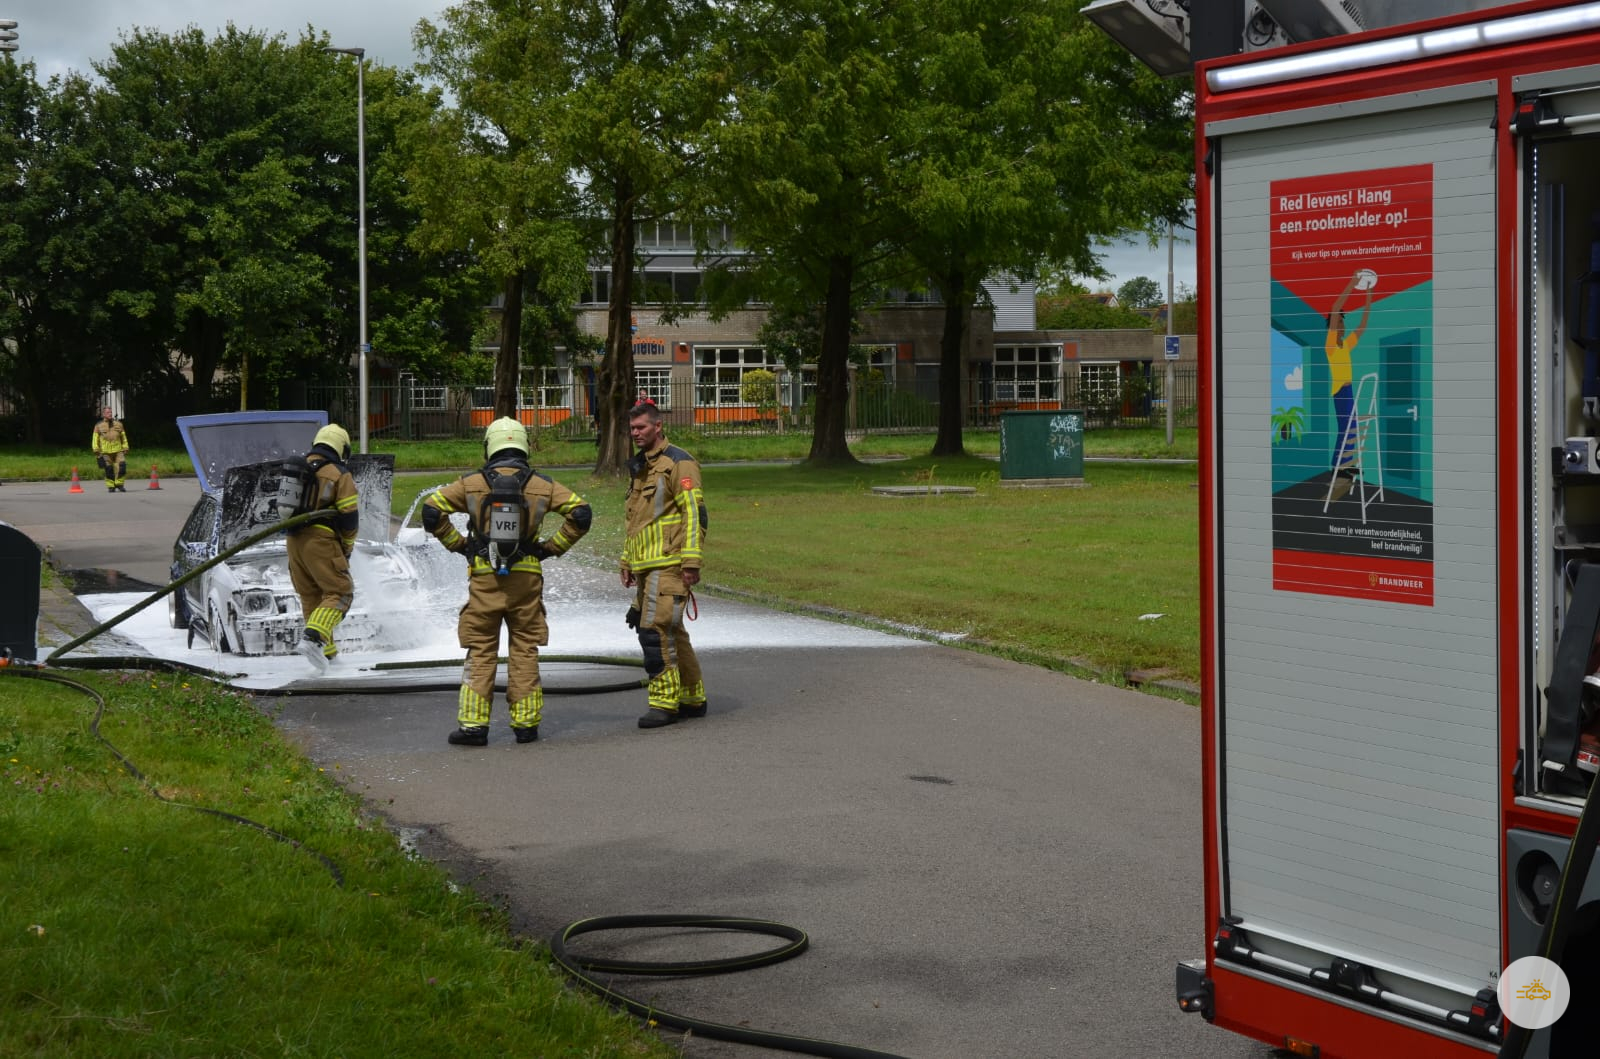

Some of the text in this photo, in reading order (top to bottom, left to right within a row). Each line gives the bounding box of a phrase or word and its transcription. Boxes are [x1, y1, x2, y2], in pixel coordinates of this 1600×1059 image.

[1280, 188, 1392, 212] Red levens! Hang
[1279, 208, 1408, 234] een rookmelder op!
[1292, 250, 1304, 261] Kijk
[1304, 250, 1318, 259] voor
[1319, 249, 1331, 260] tips
[1331, 249, 1340, 259] op
[496, 521, 517, 531] VRF
[1329, 525, 1423, 540] Neem je verantwoordelijkheid,
[1371, 540, 1423, 554] leef brandveilig!
[1379, 577, 1424, 589] BRANDWEER
